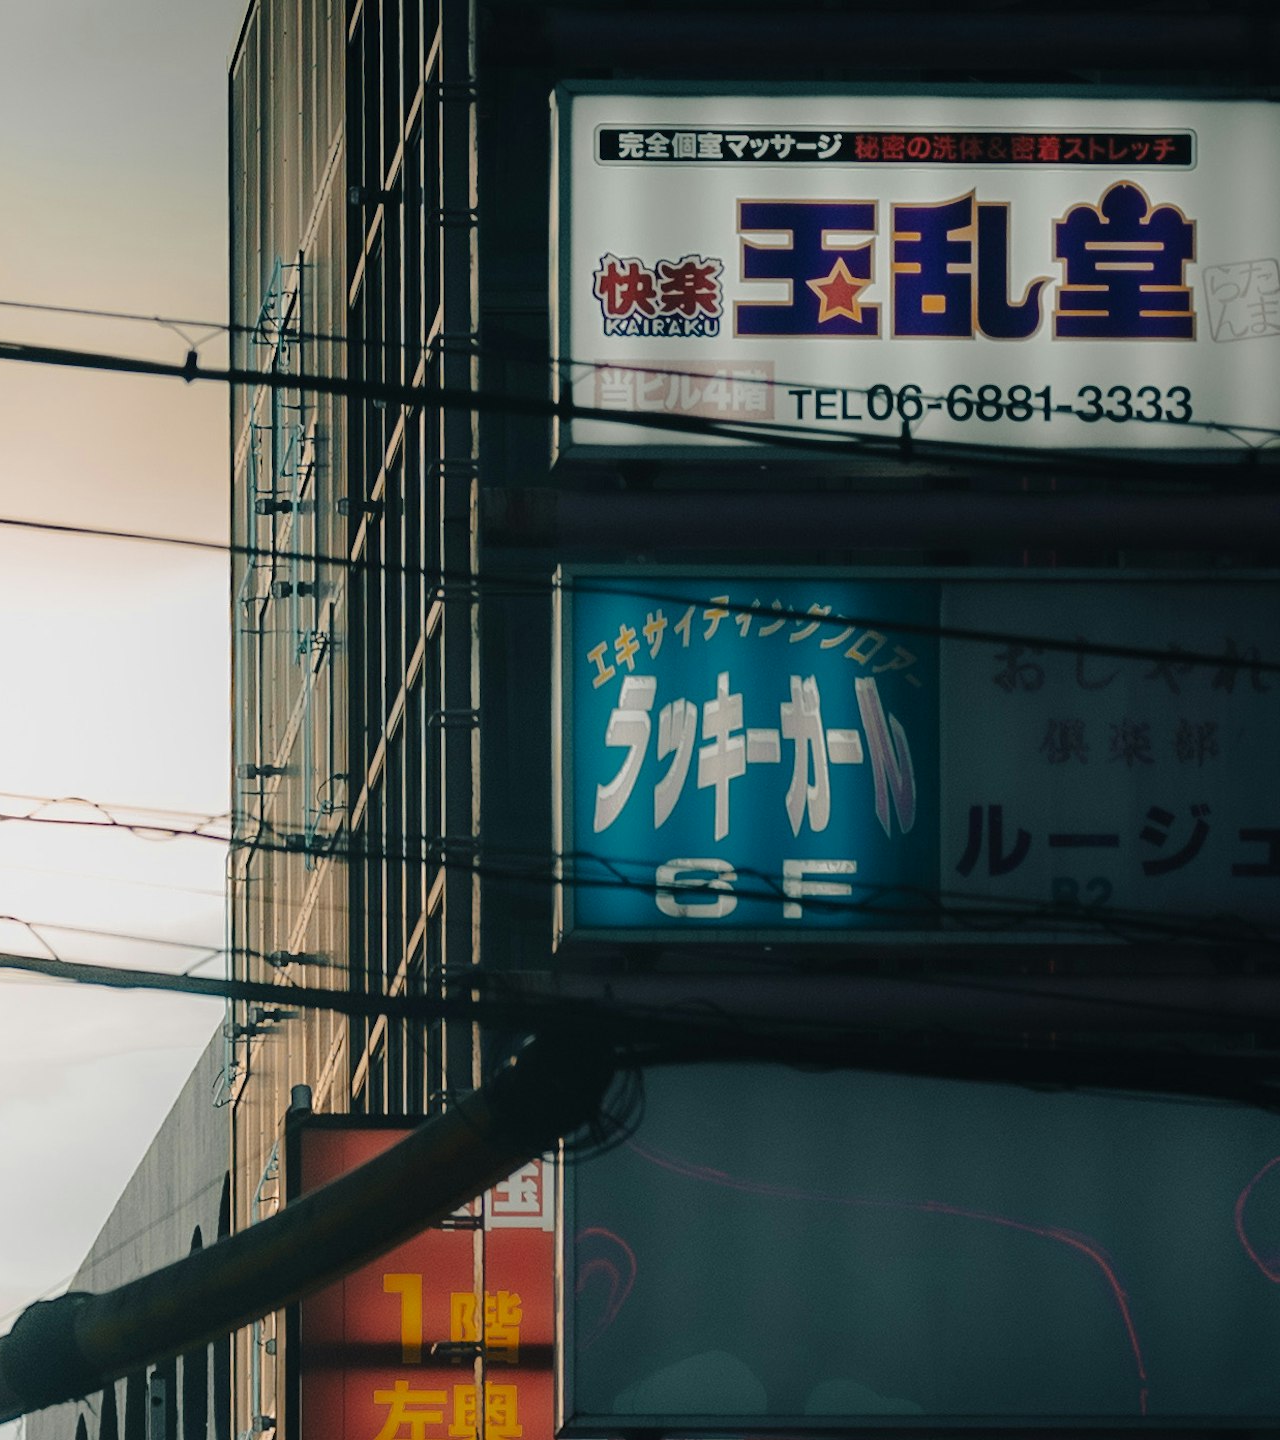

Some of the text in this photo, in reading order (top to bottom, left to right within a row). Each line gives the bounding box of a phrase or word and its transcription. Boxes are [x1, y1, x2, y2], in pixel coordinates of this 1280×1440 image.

[618, 131, 842, 160] 完全個室マッサージ
[599, 259, 720, 316] 快楽
[732, 181, 1197, 341] 玉乱堂
[604, 318, 720, 338] KAIRAKU
[601, 368, 768, 413] 当ビル4階
[788, 384, 1193, 424] TEL 06-6881-3333
[991, 636, 1271, 694] おしゃれ
[593, 672, 917, 842] ラッキーガール
[382, 1273, 523, 1365] 1階
